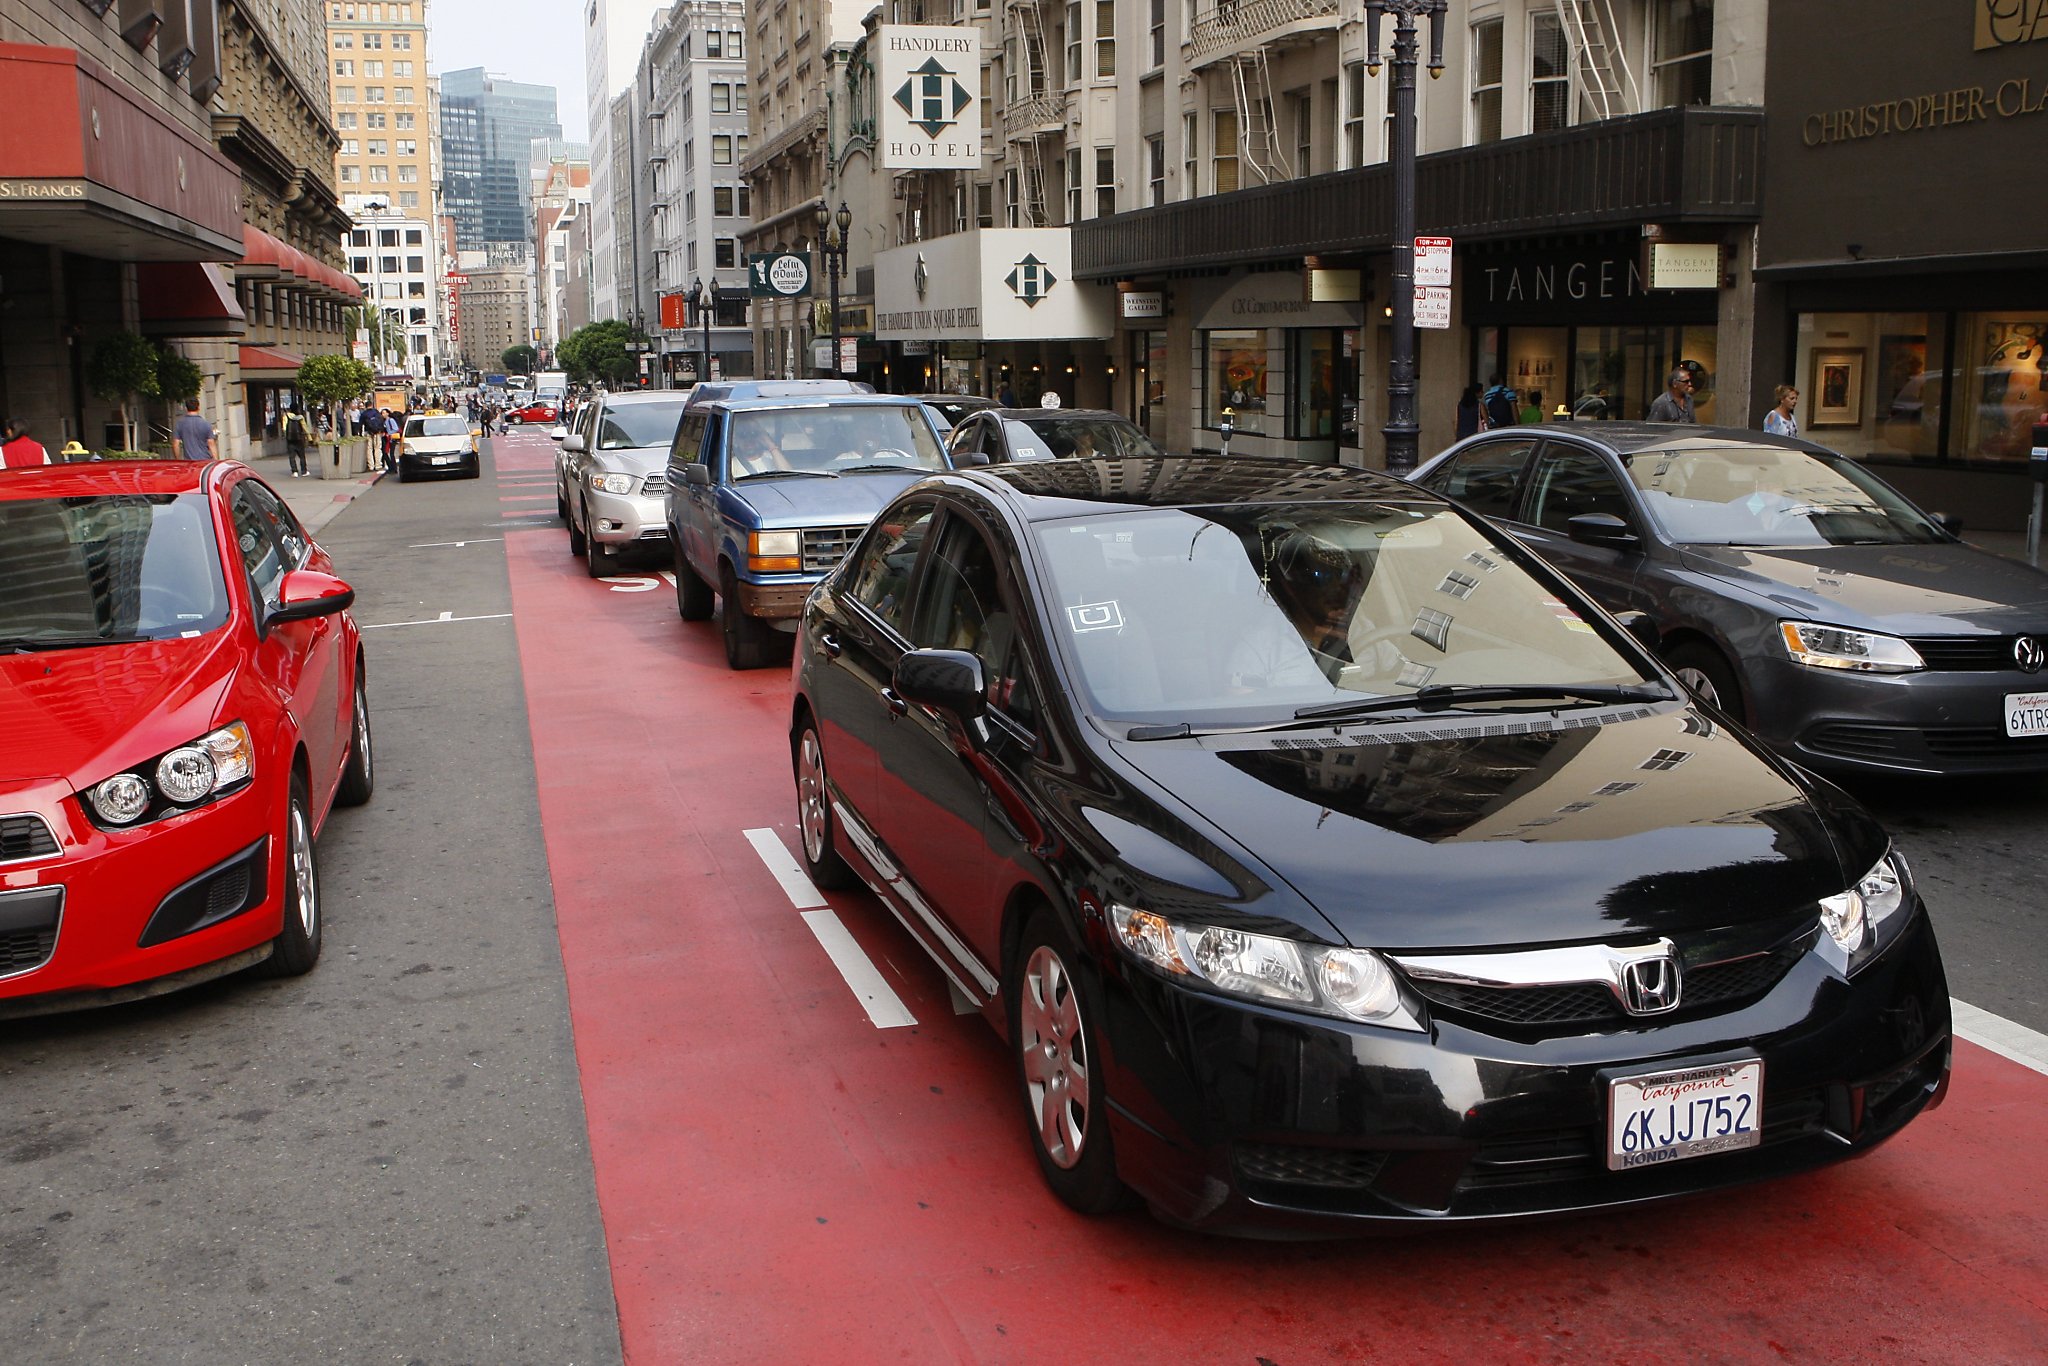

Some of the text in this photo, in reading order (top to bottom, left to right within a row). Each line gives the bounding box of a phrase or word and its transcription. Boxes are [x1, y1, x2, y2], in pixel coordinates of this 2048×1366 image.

[890, 37, 972, 53] HANDLERY
[890, 142, 976, 157] HOTEL
[20, 183, 83, 197] FRANCIS
[490, 250, 517, 258] PALACE
[1415, 246, 1450, 255] NO STOPPING
[1658, 258, 1715, 267] TANGENT
[440, 276, 468, 284] BRITEX
[1484, 258, 1674, 301] TANGEN
[1415, 288, 1449, 300] NO PARKING
[449, 286, 458, 340] FABRICS
[877, 306, 980, 334] THE HANDLERY UNION SQUARE HOTEL
[1650, 1067, 1728, 1087] MIKE HARVEY
[1641, 1077, 1735, 1102] California
[1621, 1093, 1753, 1152] 6KJJ752
[1623, 1147, 1678, 1167] HONDA
